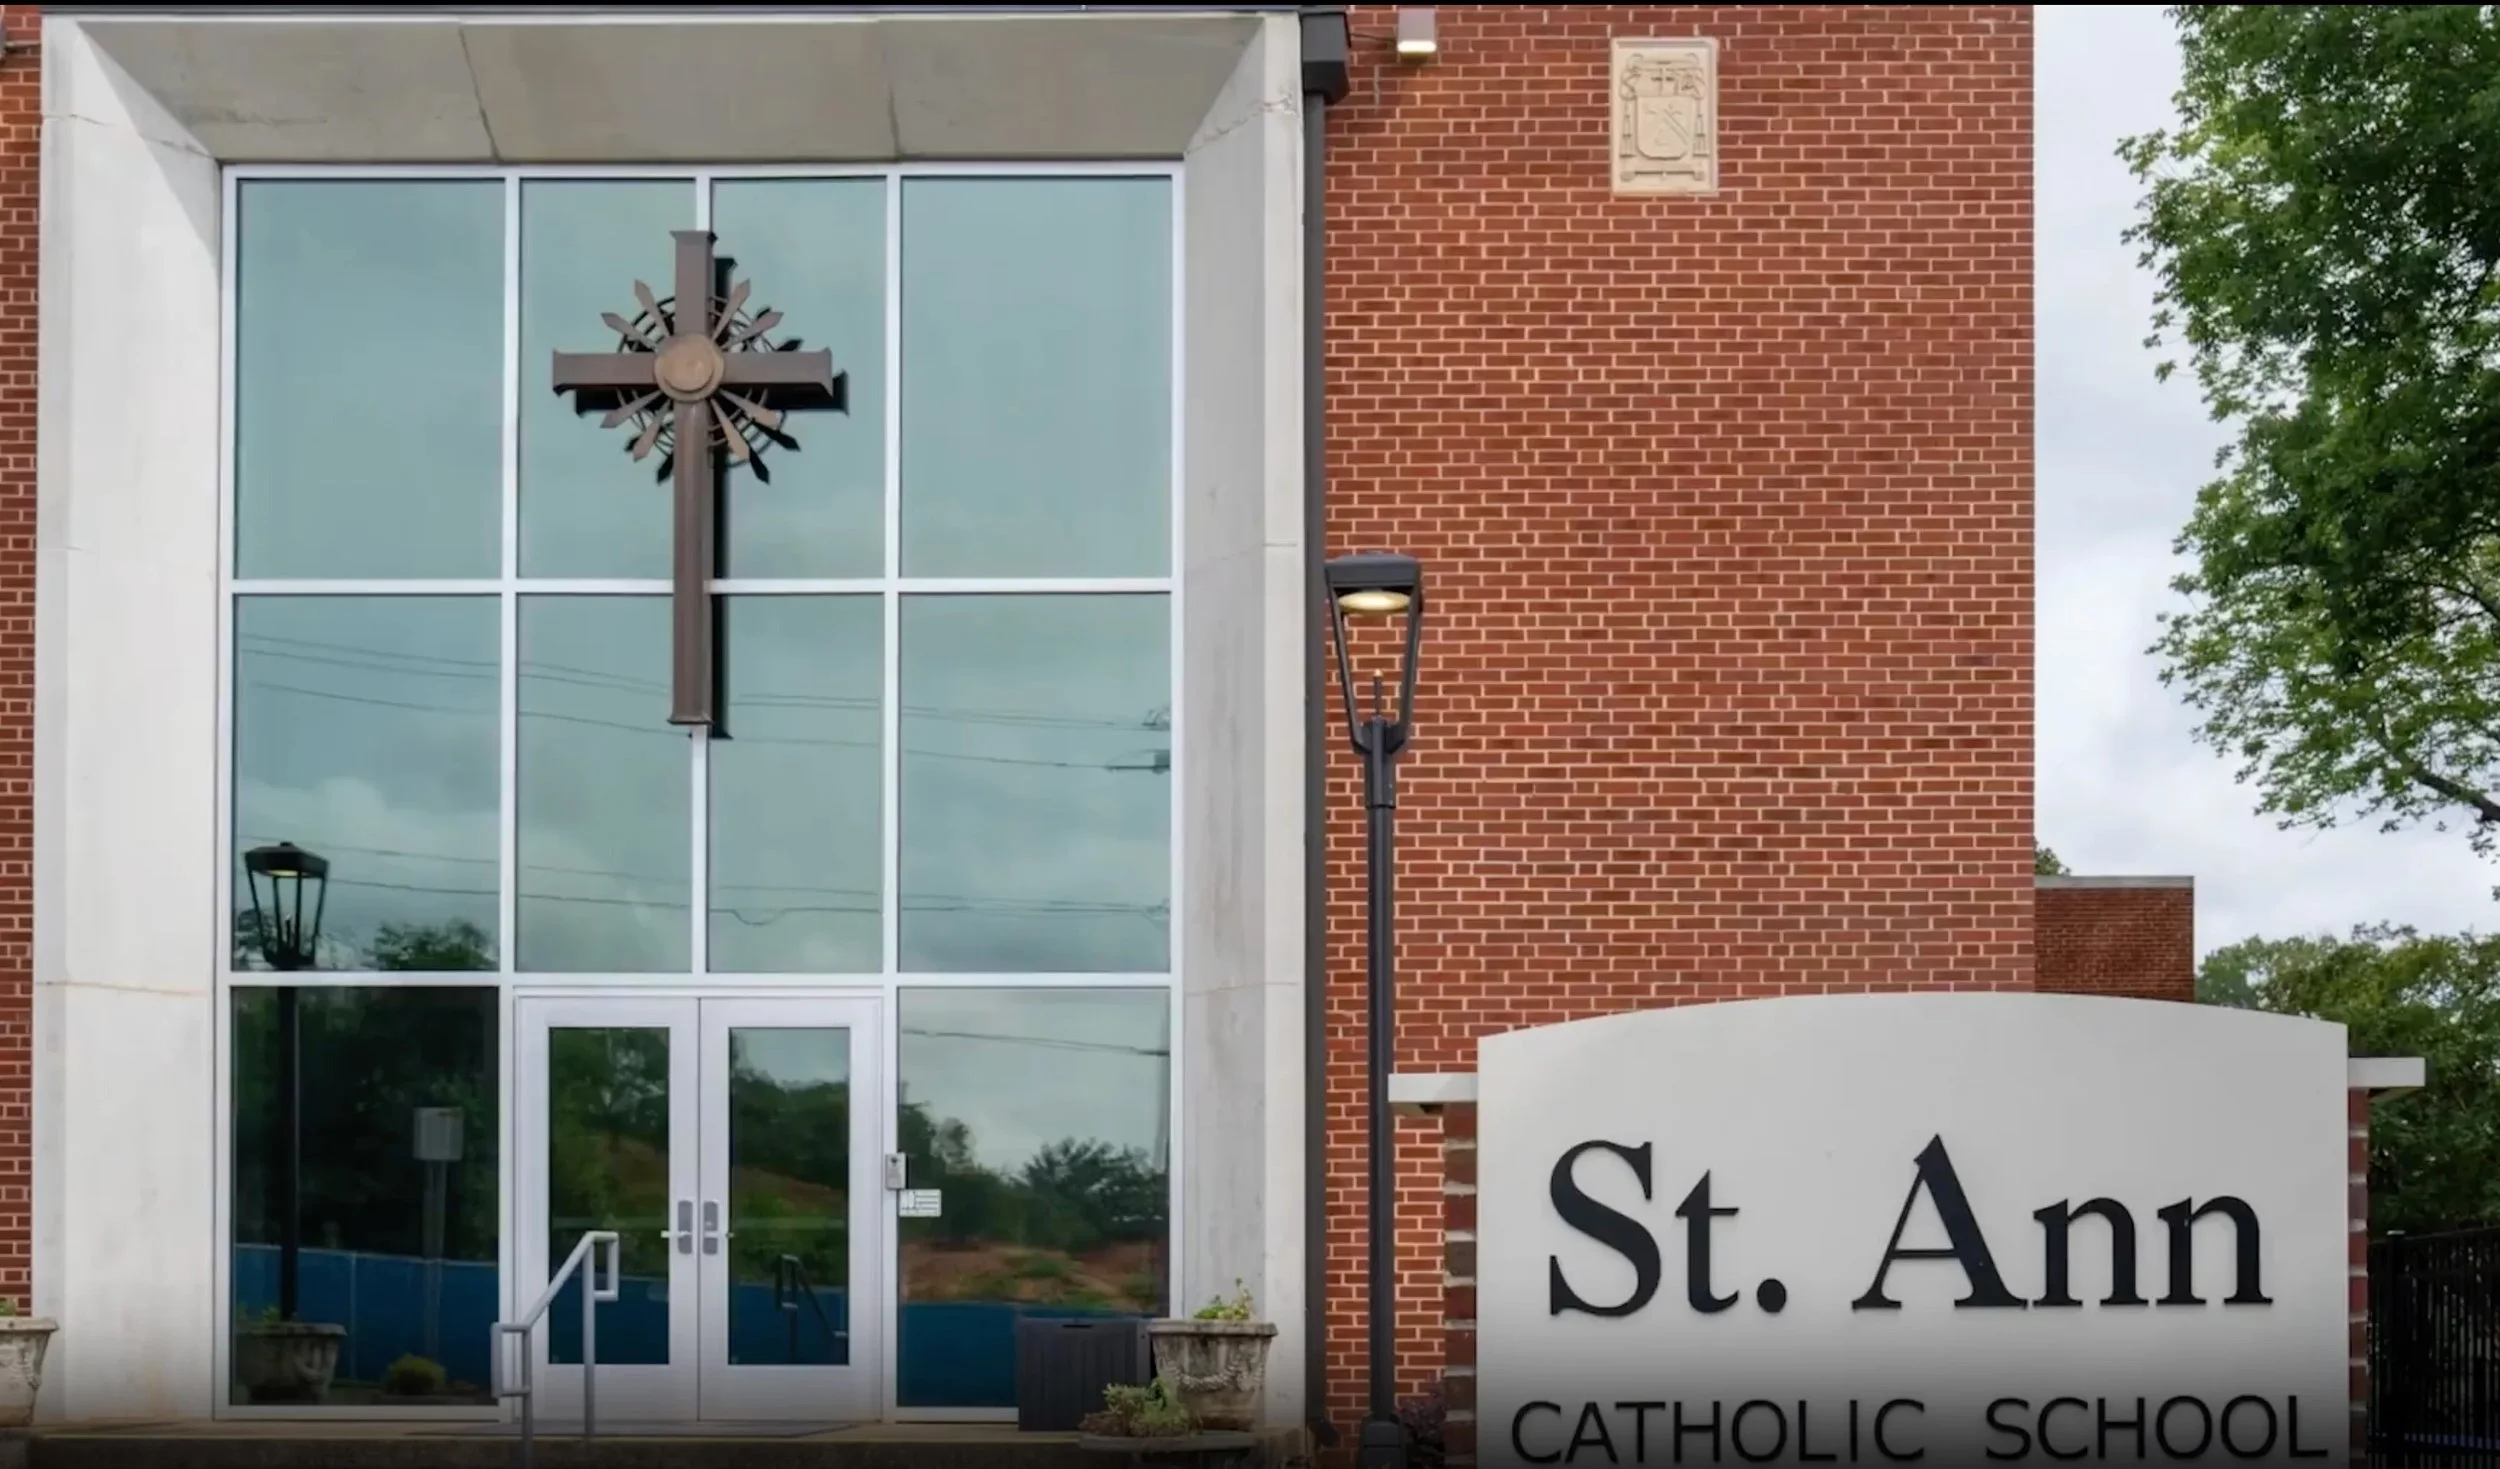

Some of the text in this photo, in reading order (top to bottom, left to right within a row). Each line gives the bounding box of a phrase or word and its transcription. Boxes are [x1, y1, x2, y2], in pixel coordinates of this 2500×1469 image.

[1550, 1134, 2273, 1317] St. Ann
[1511, 1395, 2329, 1465] CATHOLIC SCHOOL
